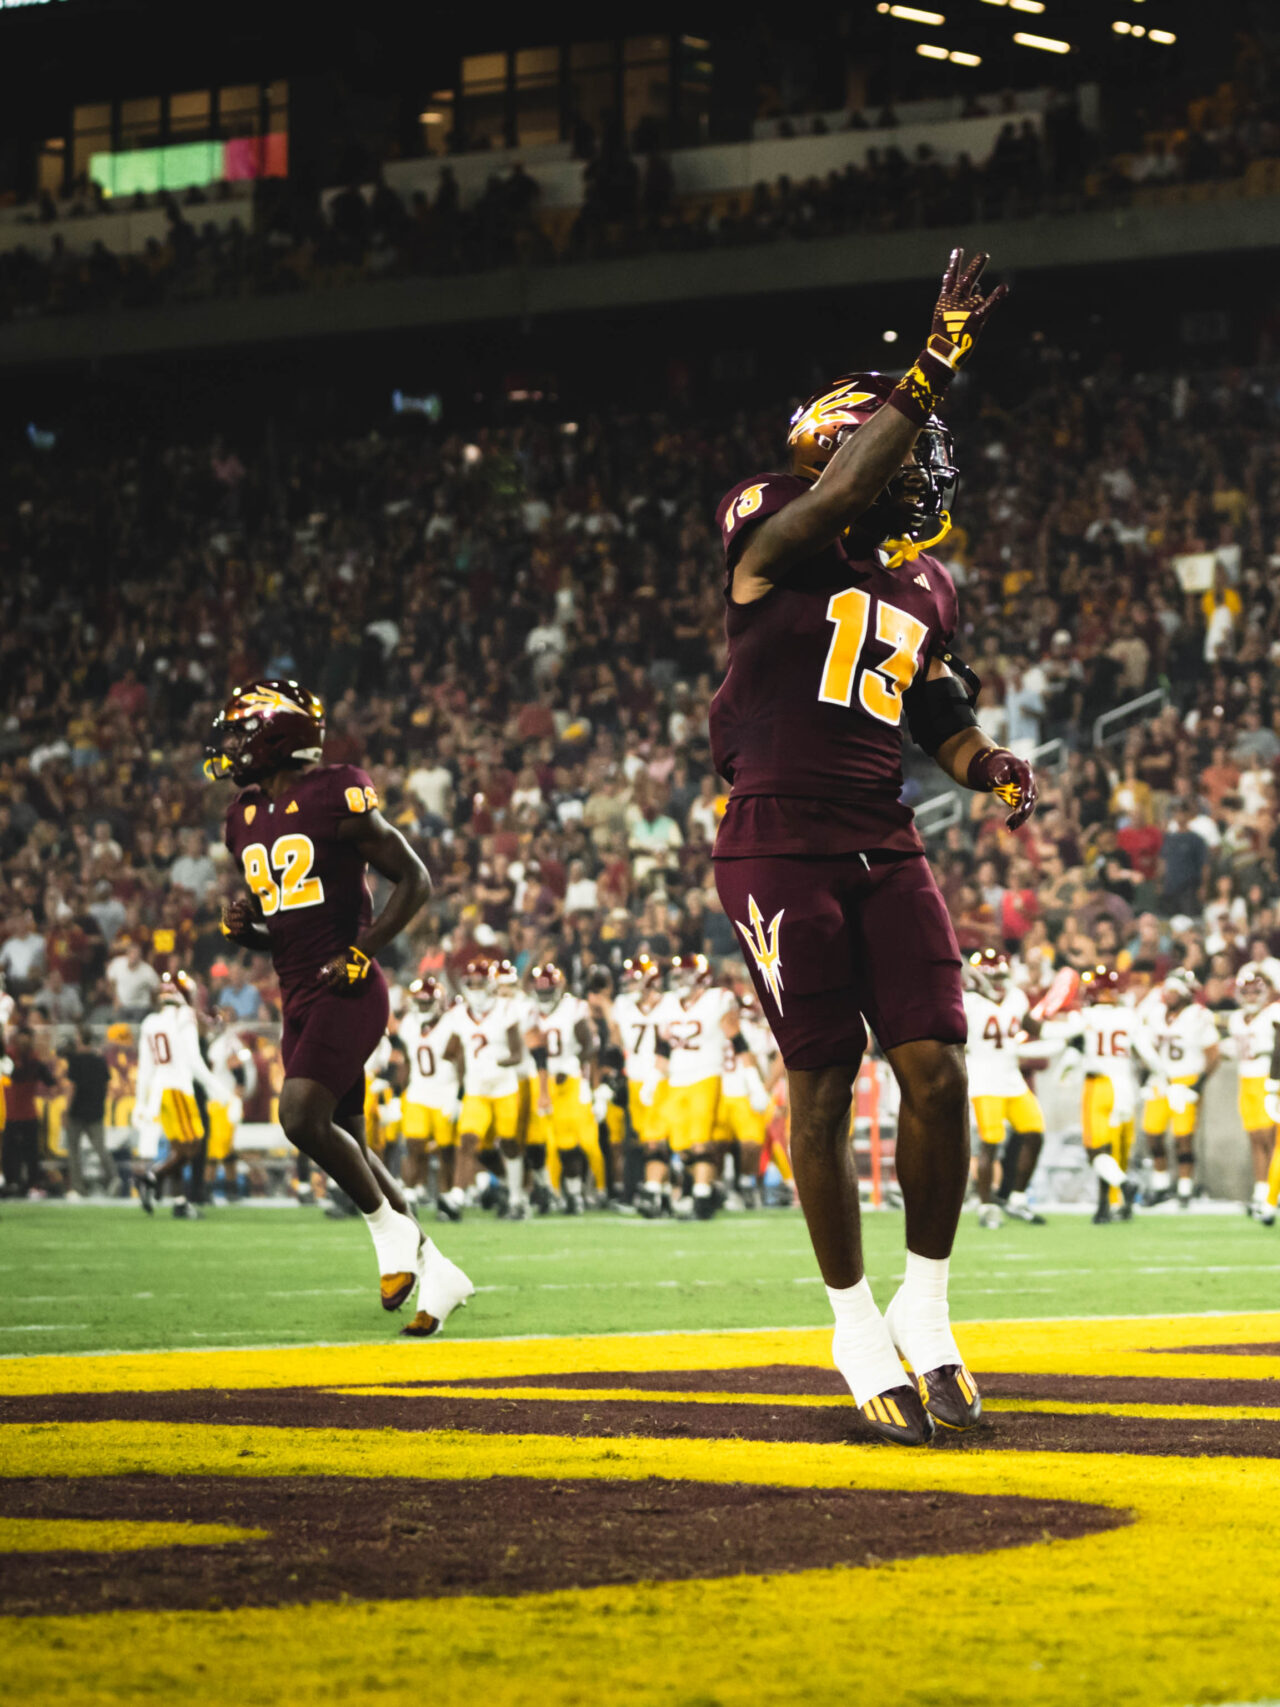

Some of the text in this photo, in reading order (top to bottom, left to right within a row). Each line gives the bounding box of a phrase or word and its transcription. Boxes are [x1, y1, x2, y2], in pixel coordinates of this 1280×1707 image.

[817, 587, 929, 726] 13
[242, 834, 325, 916] 82
[417, 1046, 436, 1077] 0
